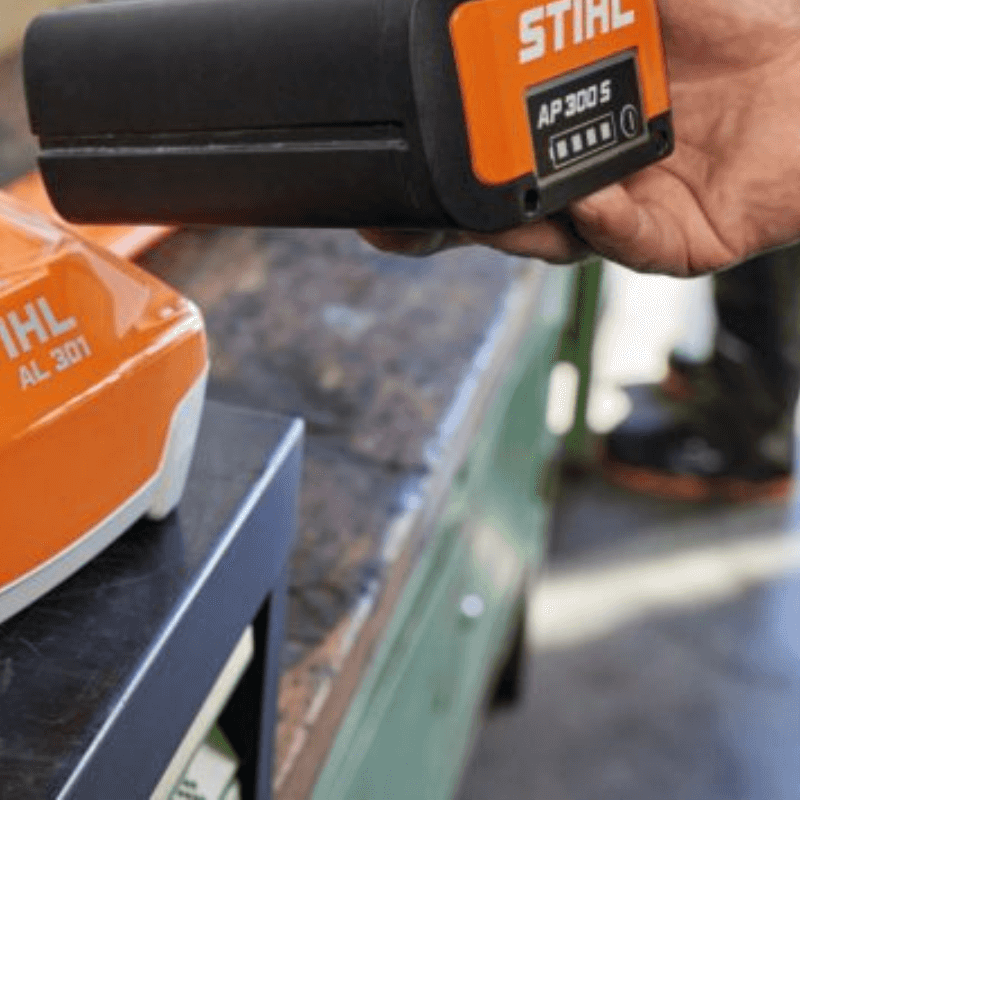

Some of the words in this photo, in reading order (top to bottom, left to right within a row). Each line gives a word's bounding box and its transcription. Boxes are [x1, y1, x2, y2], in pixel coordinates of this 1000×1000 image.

[536, 99, 564, 130] AP
[563, 84, 597, 118] 300
[598, 79, 612, 104] S
[18, 360, 50, 390] AL
[50, 335, 92, 373] 301
